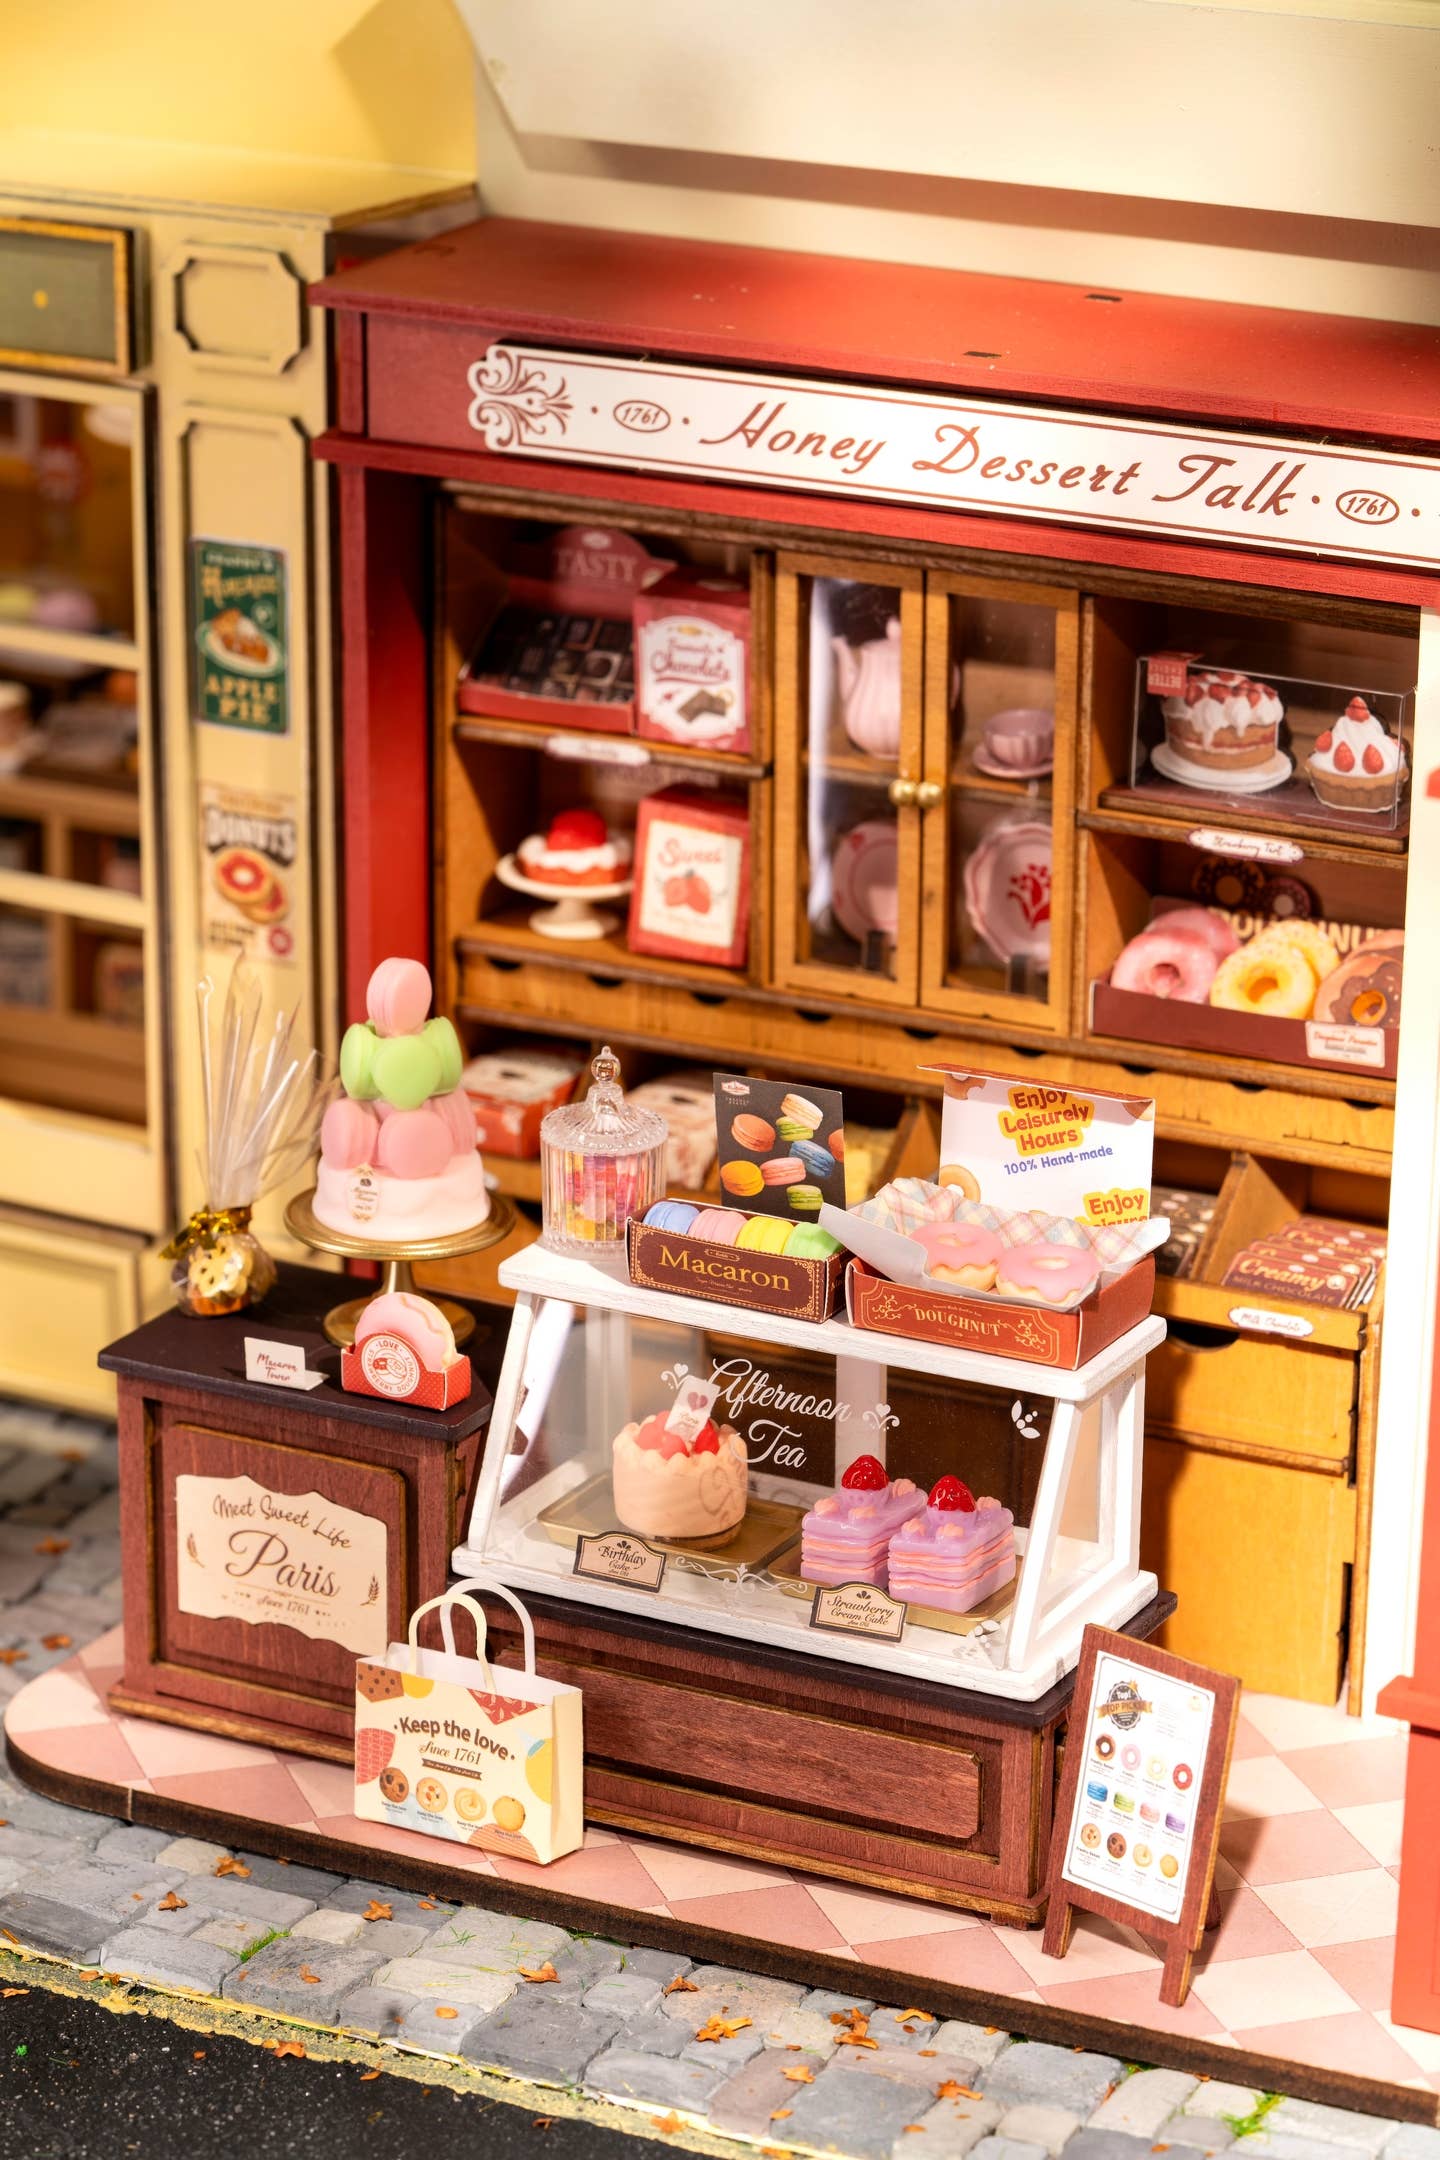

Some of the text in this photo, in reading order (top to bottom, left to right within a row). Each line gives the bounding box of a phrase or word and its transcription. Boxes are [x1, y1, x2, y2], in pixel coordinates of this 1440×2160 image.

[620, 401, 1390, 518] 1761 Honey Dessert Talk 1761
[556, 550, 638, 582] TASTY
[206, 674, 277, 704] APPLE
[219, 697, 271, 724] PIE
[1013, 1088, 1068, 1110] Enjoy
[1003, 1104, 1089, 1134] Leisurely
[1020, 1127, 1079, 1152] Hours
[1004, 1145, 1114, 1176] 100% Hand-made
[1088, 1194, 1144, 1216] Enjoy
[659, 1245, 792, 1292] Macaron
[1239, 1258, 1326, 1293] Creamy
[1263, 1282, 1336, 1302] CHOCOLATE
[914, 1307, 1001, 1337] DOUGHNUT
[378, 1339, 400, 1350] LOVE
[256, 1352, 298, 1373] Macaron
[707, 1358, 855, 1423] Afternoon
[729, 1419, 808, 1469] Tea
[213, 1494, 352, 1549] Meet Sweet Life
[225, 1529, 341, 1597] Paris
[598, 1545, 647, 1569] Birthday
[608, 1559, 631, 1571] Cake
[286, 1601, 311, 1616] 1761
[826, 1595, 895, 1619] Strawberry
[830, 1607, 862, 1621] Cream
[864, 1613, 889, 1626] Cake
[399, 1716, 509, 1760] Keep the love
[419, 1741, 482, 1765] Since 1761
